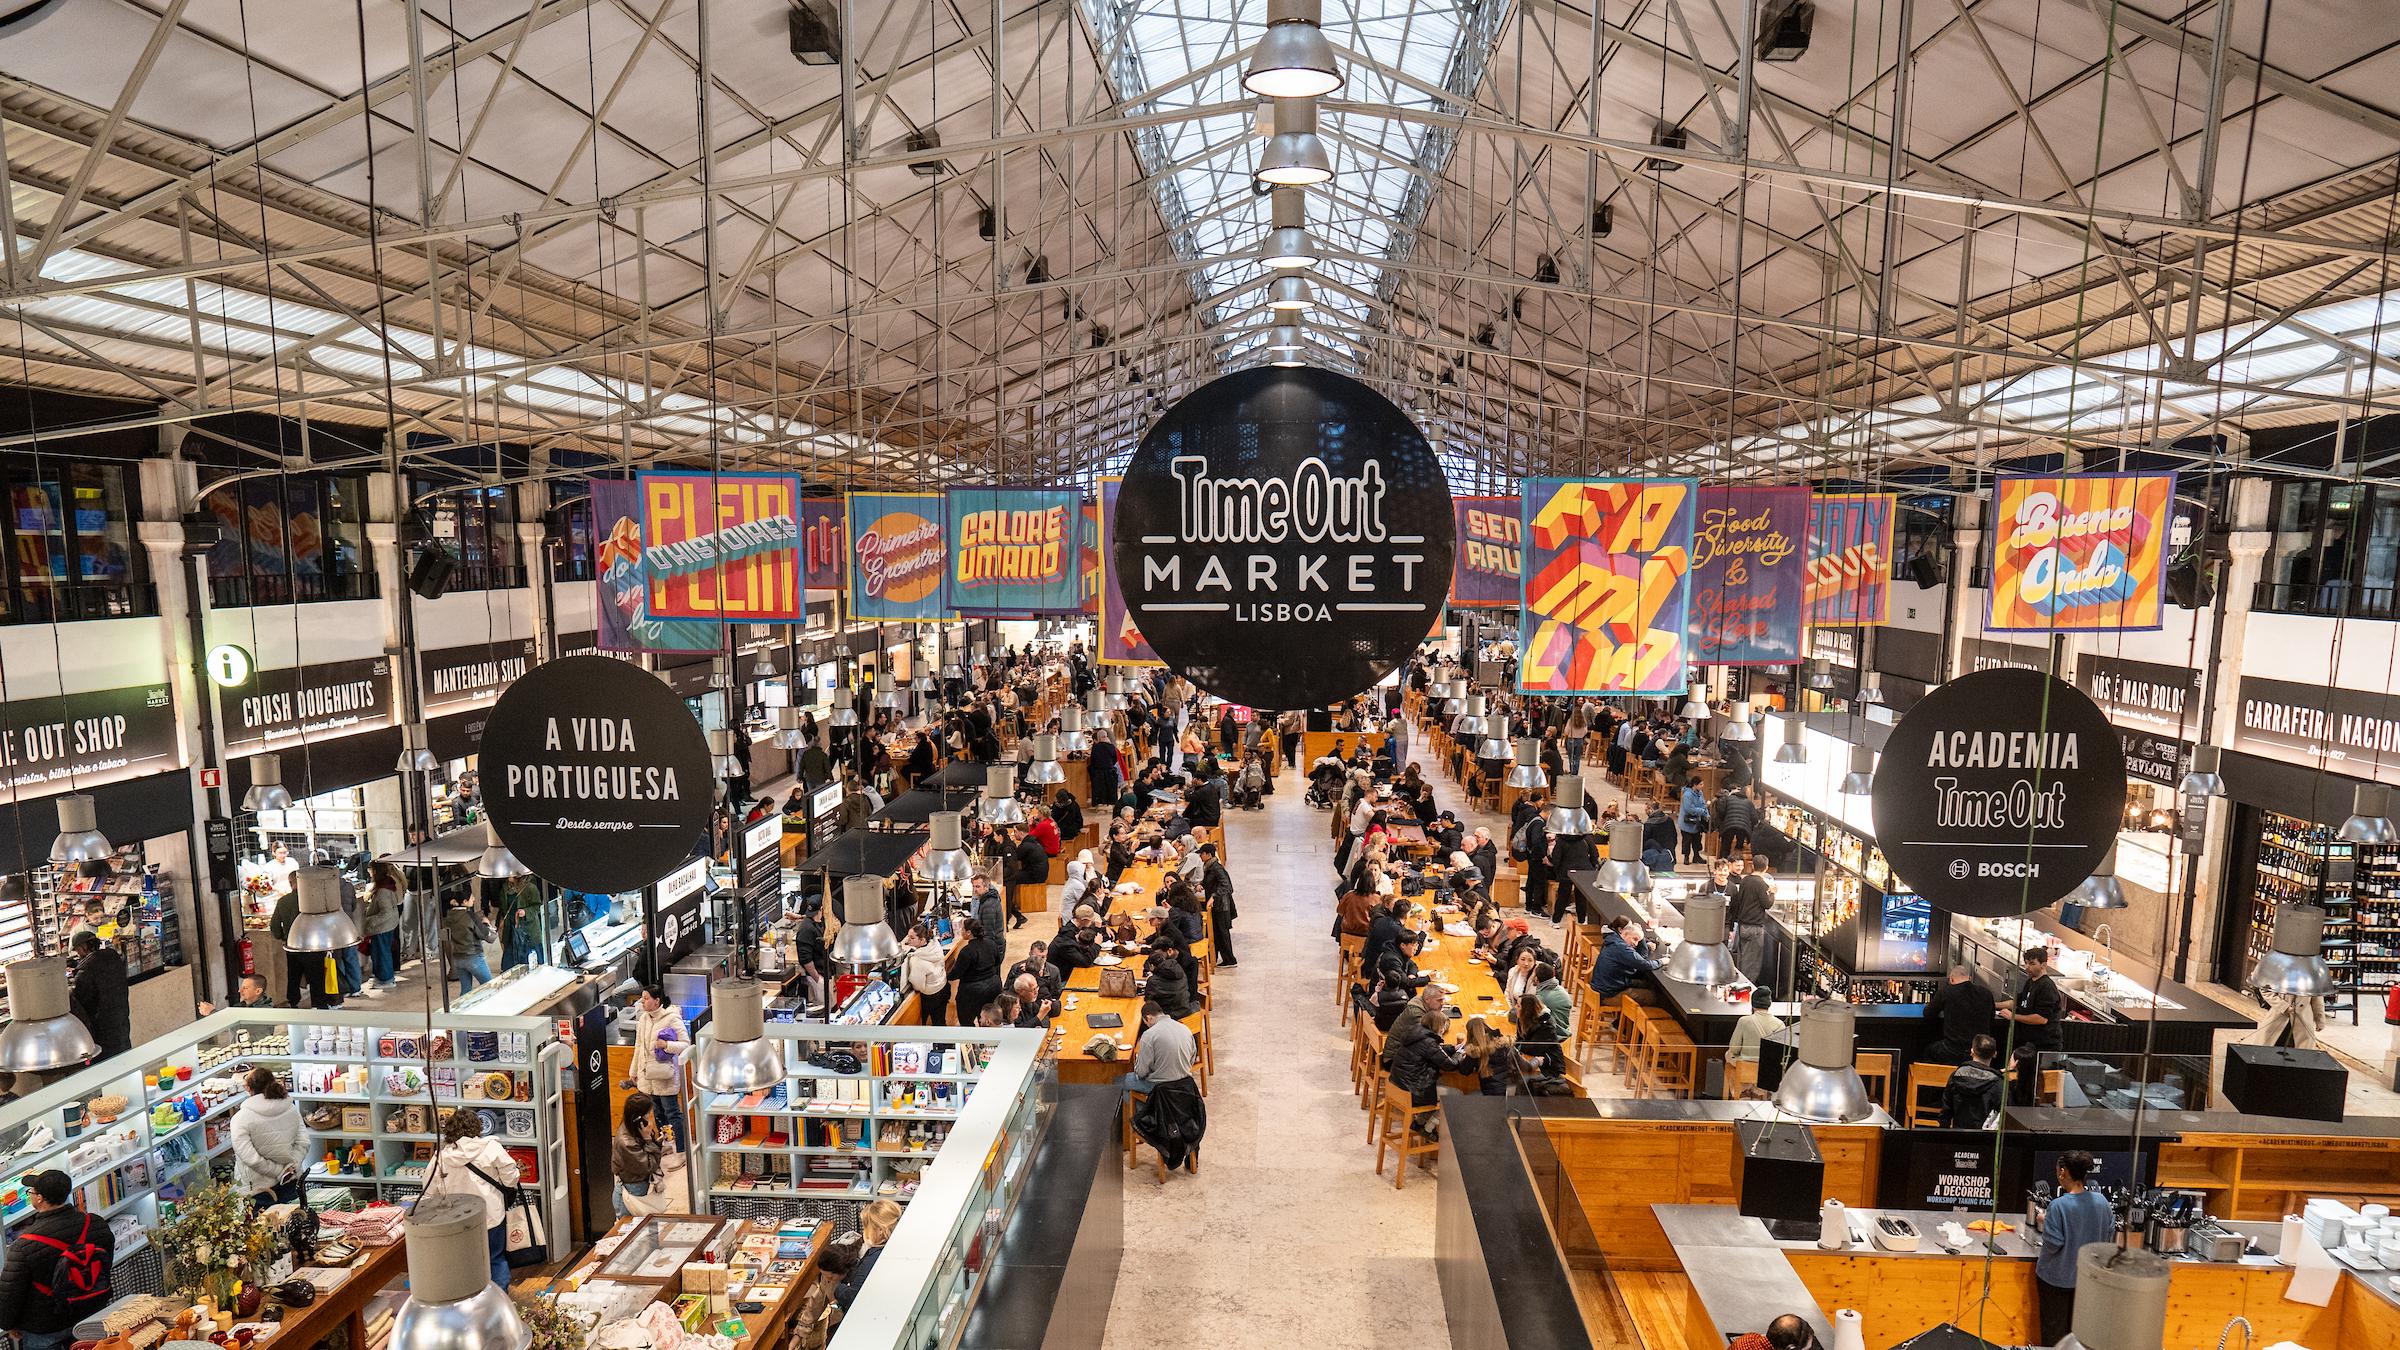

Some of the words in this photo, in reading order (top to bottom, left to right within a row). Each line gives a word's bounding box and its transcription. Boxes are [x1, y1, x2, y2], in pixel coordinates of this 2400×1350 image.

[960, 504, 1066, 548] CALORE
[1703, 507, 1771, 538] Food
[2010, 491, 2137, 549] Buena
[856, 522, 940, 562] Primeiro
[1692, 530, 1795, 570] Diversity
[864, 546, 947, 598] Encontro
[957, 541, 1063, 585] UMANO
[1143, 554, 1424, 592] MARKET
[1725, 557, 1748, 586] &
[2020, 539, 2121, 605] Onda
[1236, 603, 1333, 622] LISBOA
[1690, 585, 1777, 625] Shared
[433, 661, 499, 695] MANTEIGARIA
[501, 656, 527, 683] SILVA
[2091, 671, 2111, 701] NÓS
[2113, 673, 2121, 702] É
[2122, 679, 2148, 708] MAIS
[243, 692, 292, 728] CRUSH
[297, 680, 374, 718] DOUGHNUTS
[2244, 699, 2334, 742] GARRAFEIRA
[24, 722, 65, 763] OUT
[74, 714, 126, 755] SHOP
[546, 717, 562, 751] A
[571, 717, 636, 751] VIDA
[1928, 730, 2079, 769] ACADEMIA
[507, 764, 680, 801] PORTUGUESA
[2126, 755, 2173, 781] PAVLOVA
[555, 816, 592, 830] Desde
[592, 820, 634, 832] sempre
[1977, 862, 2040, 878] BOSCH
[1954, 1151, 1979, 1160] ACADEMIA
[1933, 1185, 1942, 1196] A
[1943, 1184, 1992, 1199] DECORRER
[1938, 1174, 1990, 1188] WORKSHOP
[1926, 1195, 1957, 1204] WORKSHOP
[1958, 1196, 1979, 1206] TAKING
